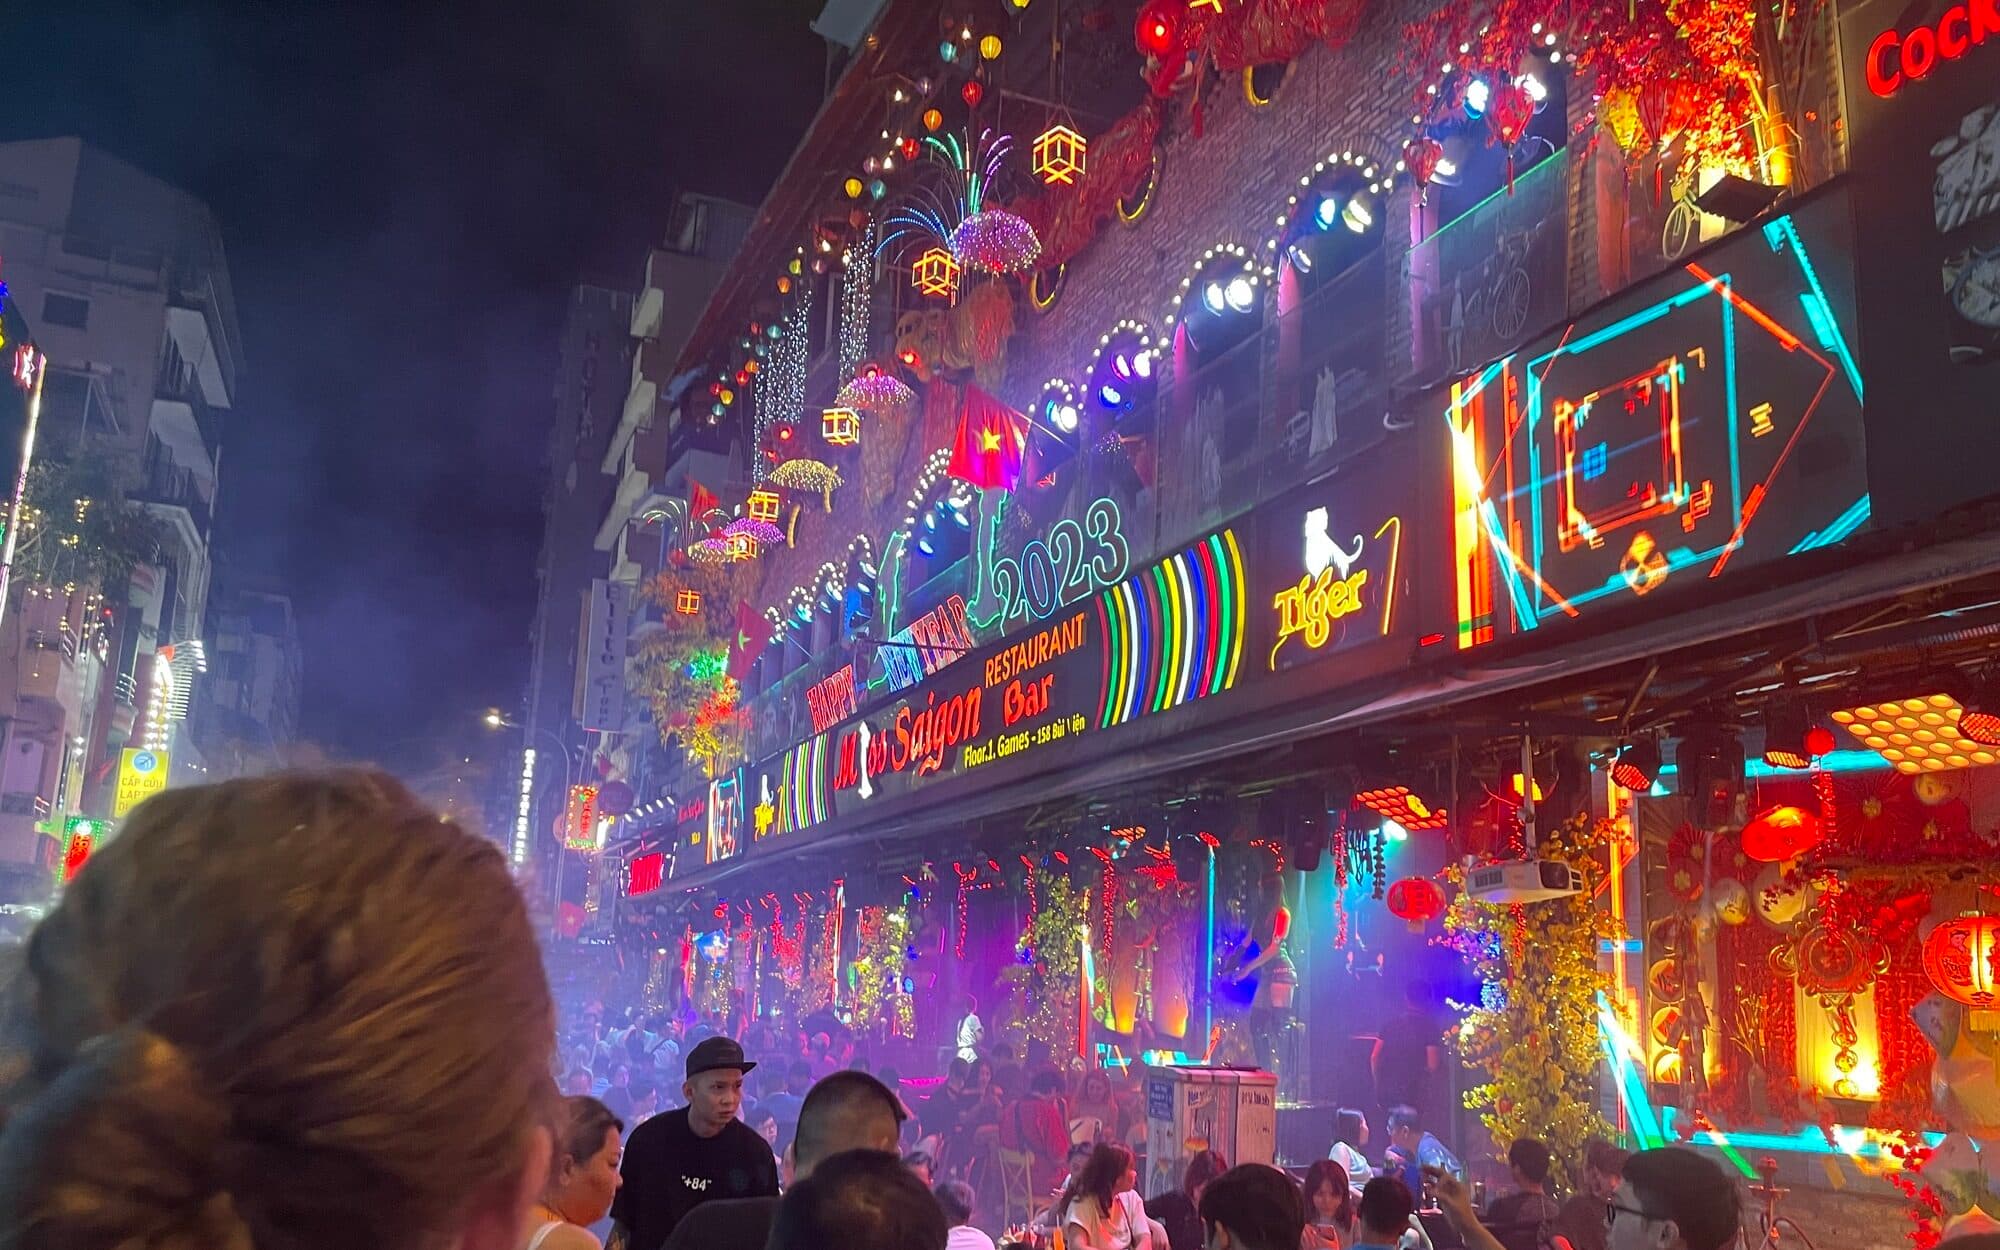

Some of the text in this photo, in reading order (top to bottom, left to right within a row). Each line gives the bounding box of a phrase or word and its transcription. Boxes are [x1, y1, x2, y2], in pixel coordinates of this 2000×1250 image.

[806, 498, 1129, 734] HAPPY NEW YEAR 2023
[1274, 566, 1368, 648] Tiger
[984, 613, 1086, 688] RESTAURANT
[891, 687, 982, 777] Saigon
[1004, 674, 1054, 727] Bar
[997, 731, 1030, 757] Games
[1037, 725, 1051, 744] 158
